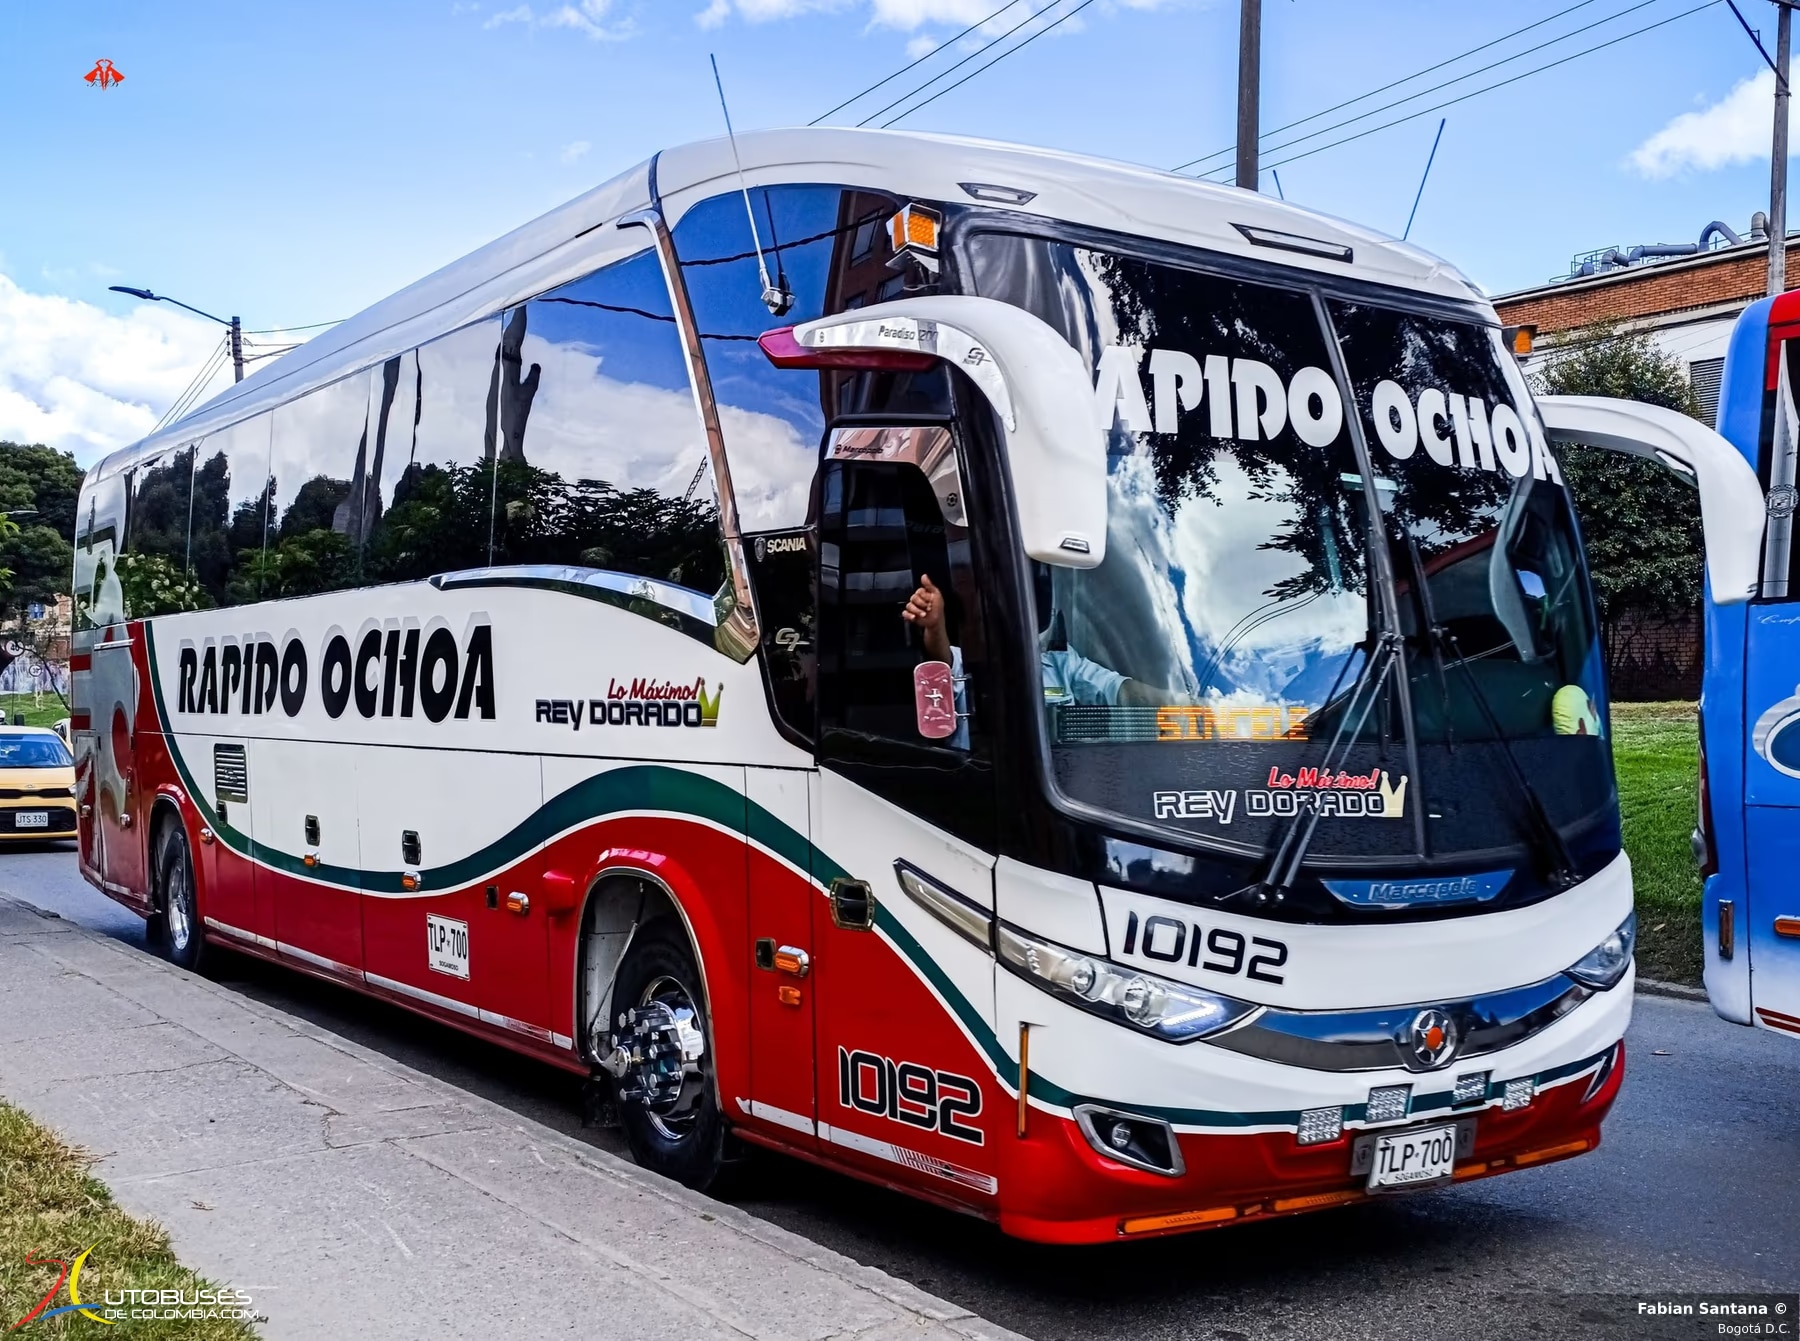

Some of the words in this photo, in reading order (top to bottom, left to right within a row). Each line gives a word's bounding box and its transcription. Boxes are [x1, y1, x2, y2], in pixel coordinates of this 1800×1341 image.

[878, 325, 915, 340] Paradiso
[1093, 345, 1343, 447] APIDO
[1372, 379, 1565, 486] OCHOA
[767, 537, 807, 553] SCANIA
[178, 636, 308, 718] RAPIDO
[320, 622, 497, 724] OCHOA
[607, 677, 628, 700] Lo
[629, 676, 703, 700] Máximo!
[589, 699, 703, 728] DORADO
[1267, 766, 1298, 789] Lo
[1245, 790, 1385, 818] DORADO
[17, 815, 31, 824] JTS
[33, 815, 47, 824] 330
[1368, 877, 1479, 900] Marcopolo
[1123, 910, 1288, 985] 10192
[837, 1044, 985, 1147] 10192
